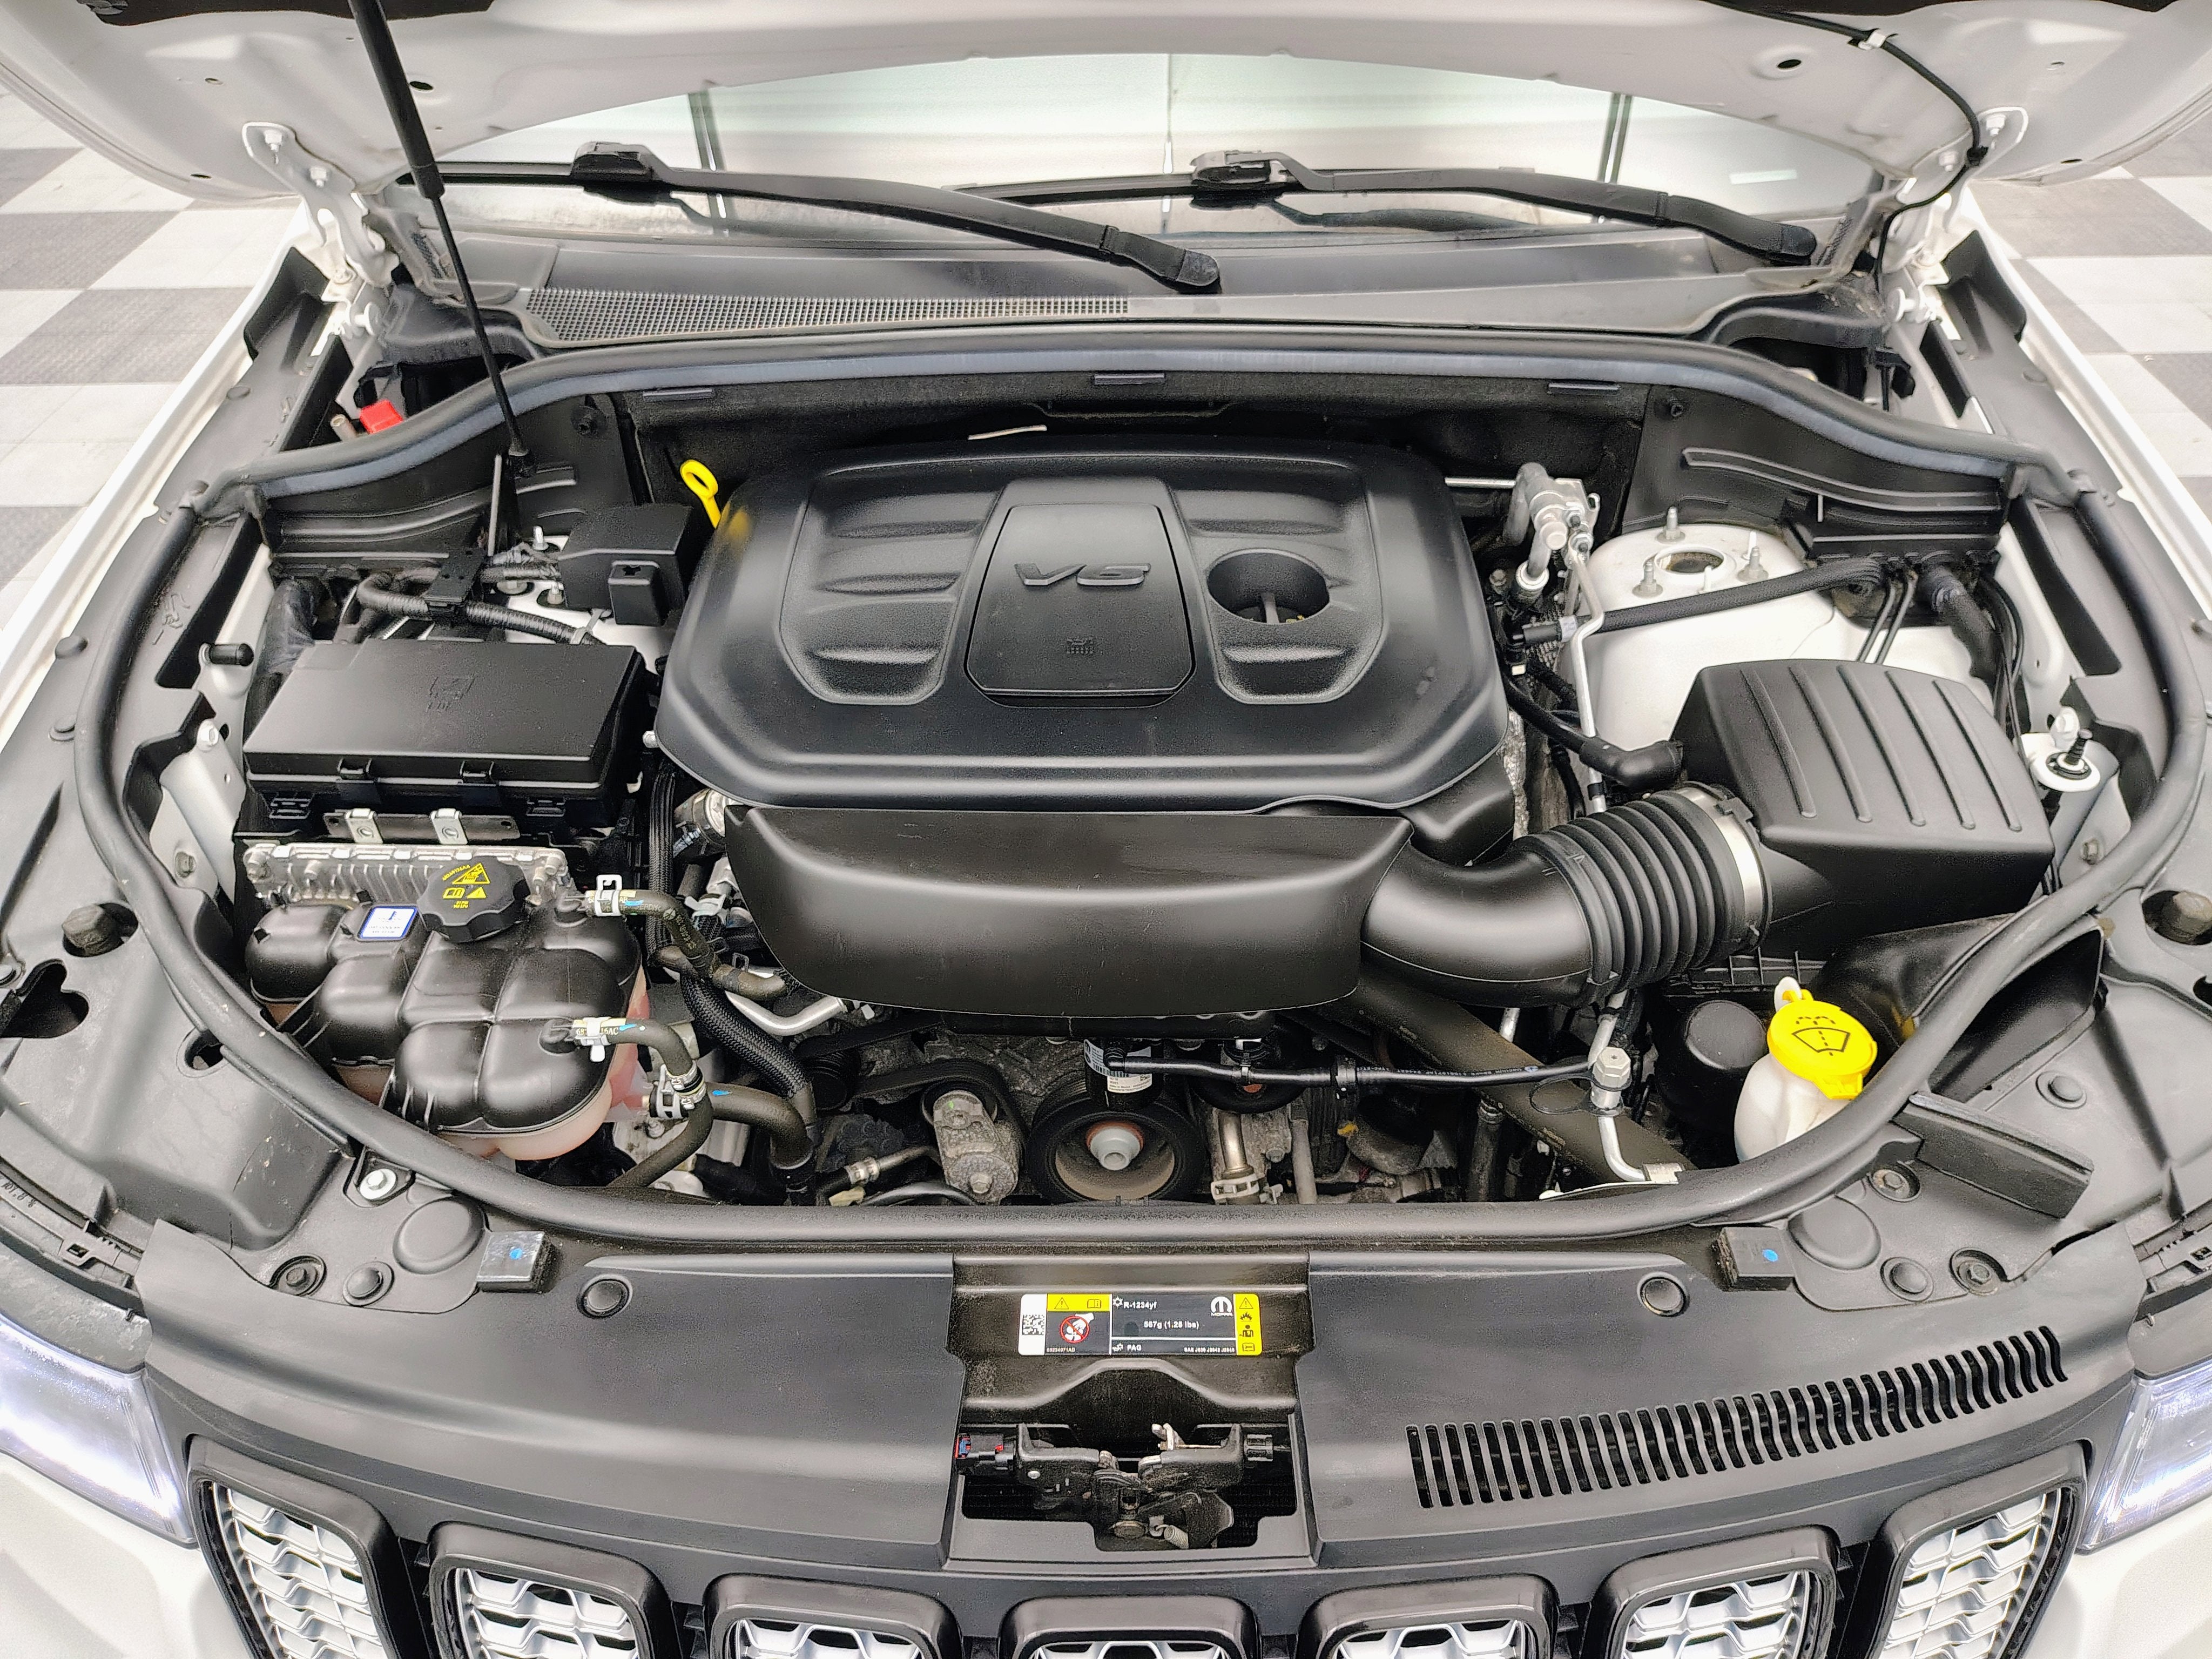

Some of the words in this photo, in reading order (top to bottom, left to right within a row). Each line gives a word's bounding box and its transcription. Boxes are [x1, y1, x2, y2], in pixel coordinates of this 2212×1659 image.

[1014, 563, 1151, 586] V6
[1123, 1301, 1157, 1310] R-1234yf
[1144, 1321, 1163, 1330] 567g
[1164, 1320, 1183, 1329] (1.25
[1185, 1320, 1200, 1330] lbs)
